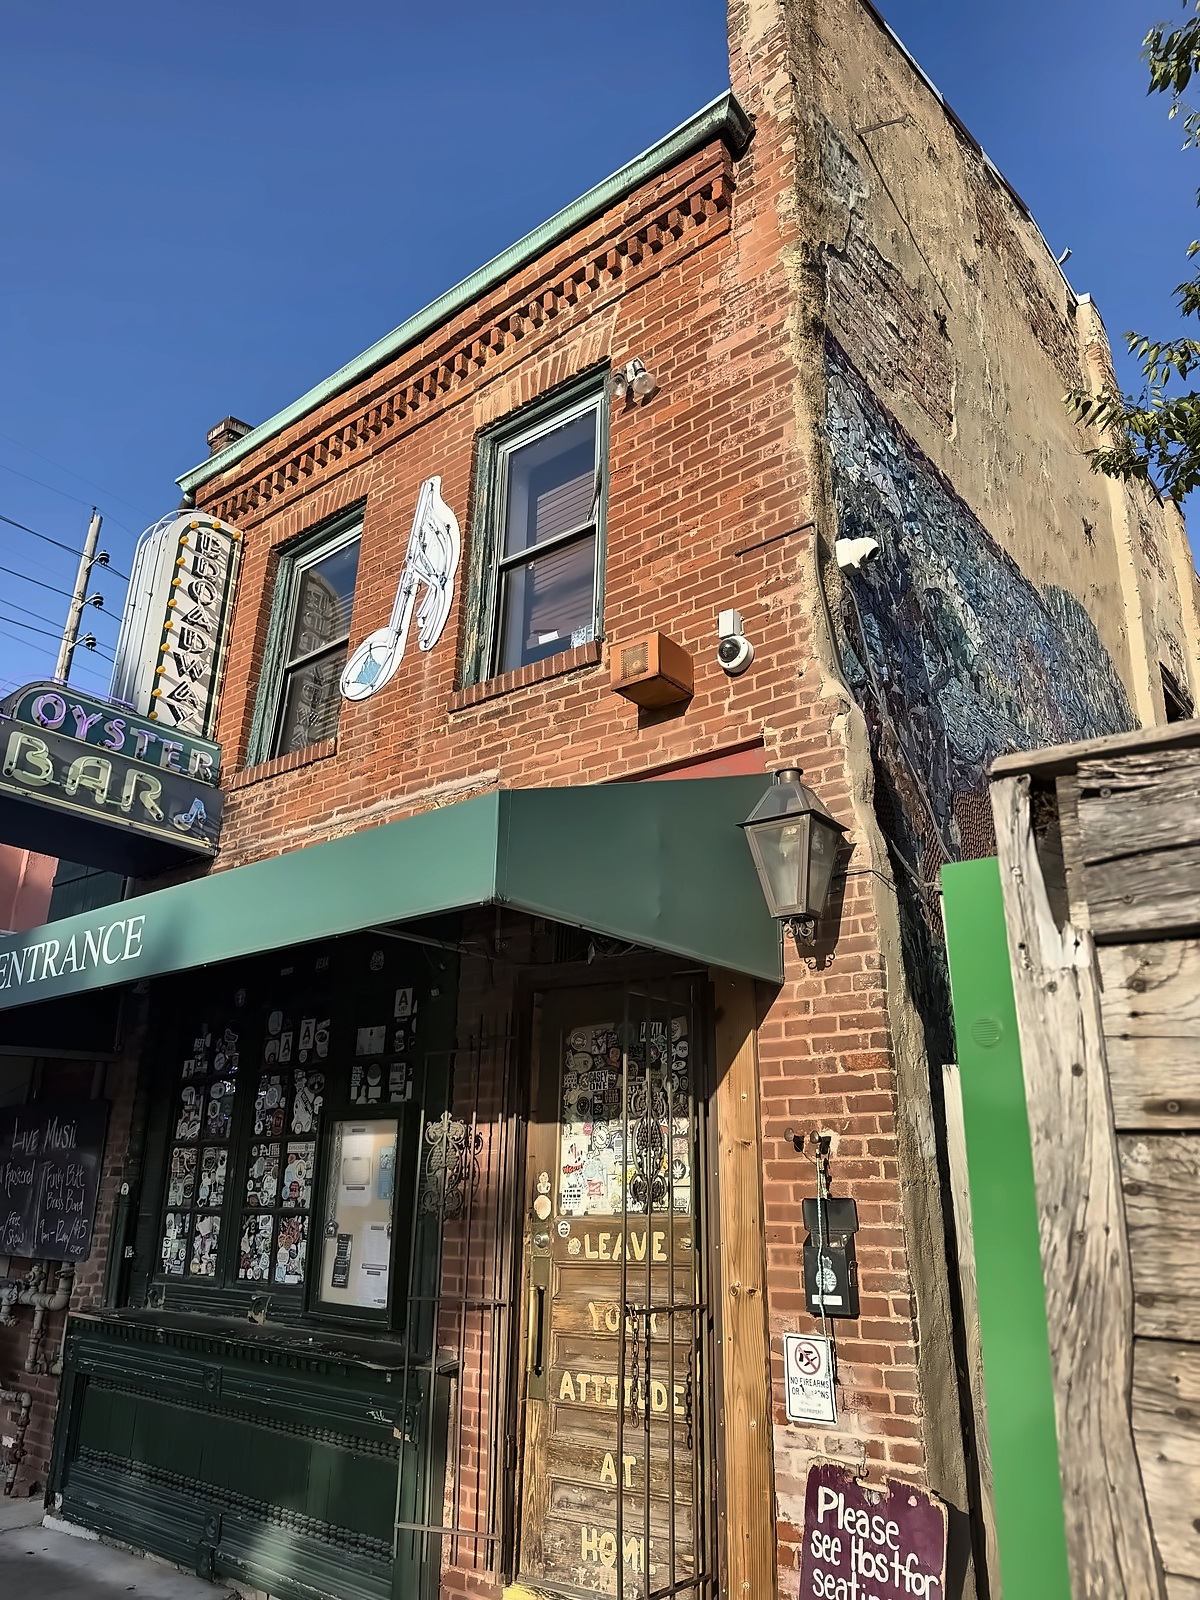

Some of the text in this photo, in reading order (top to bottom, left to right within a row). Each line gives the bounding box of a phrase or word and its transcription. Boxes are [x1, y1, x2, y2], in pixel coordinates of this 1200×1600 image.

[165, 530, 223, 729] BROADWAY
[31, 692, 214, 781] OYSTER
[2, 730, 165, 822] BAR
[0, 914, 146, 990] ENTRANCE
[589, 1081, 608, 1090] ONE
[584, 1231, 667, 1261] LEAVE
[790, 1376, 829, 1389] NO FIREARMS
[600, 1452, 637, 1488] AT
[817, 1485, 900, 1550] Please
[810, 1529, 842, 1566] see
